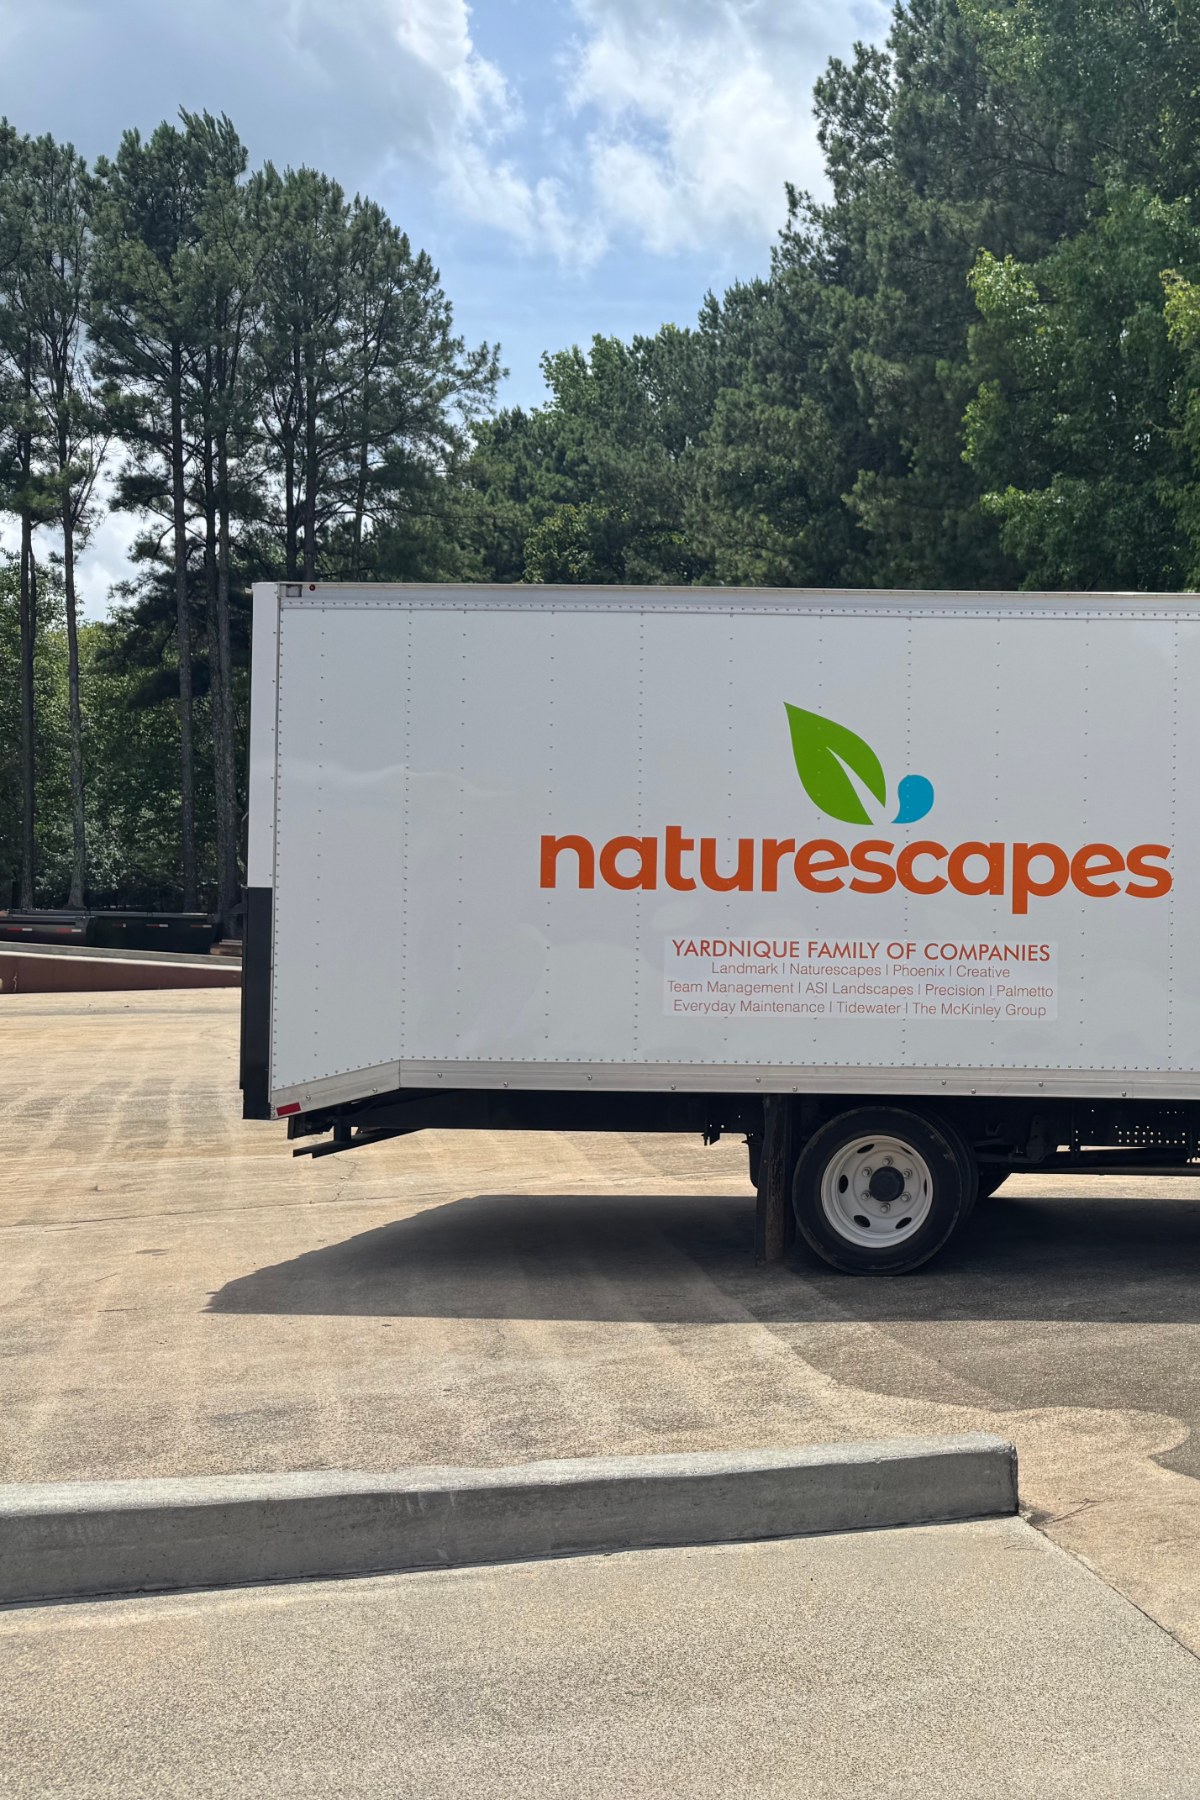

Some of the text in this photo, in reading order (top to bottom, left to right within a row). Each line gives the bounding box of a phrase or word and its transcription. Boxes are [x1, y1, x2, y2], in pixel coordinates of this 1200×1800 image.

[539, 825, 1173, 915] naturescapes
[672, 939, 1051, 962] YARDNIQUE FAMILY OF COMPANIES
[711, 961, 1010, 979] Landmark Naturescapes Phoenix Creative
[667, 980, 1054, 999] Team Management ASI Landscapes Precision Palmetto
[673, 999, 1047, 1019] Everyday Maintenance Tidewater The McKinley Group
